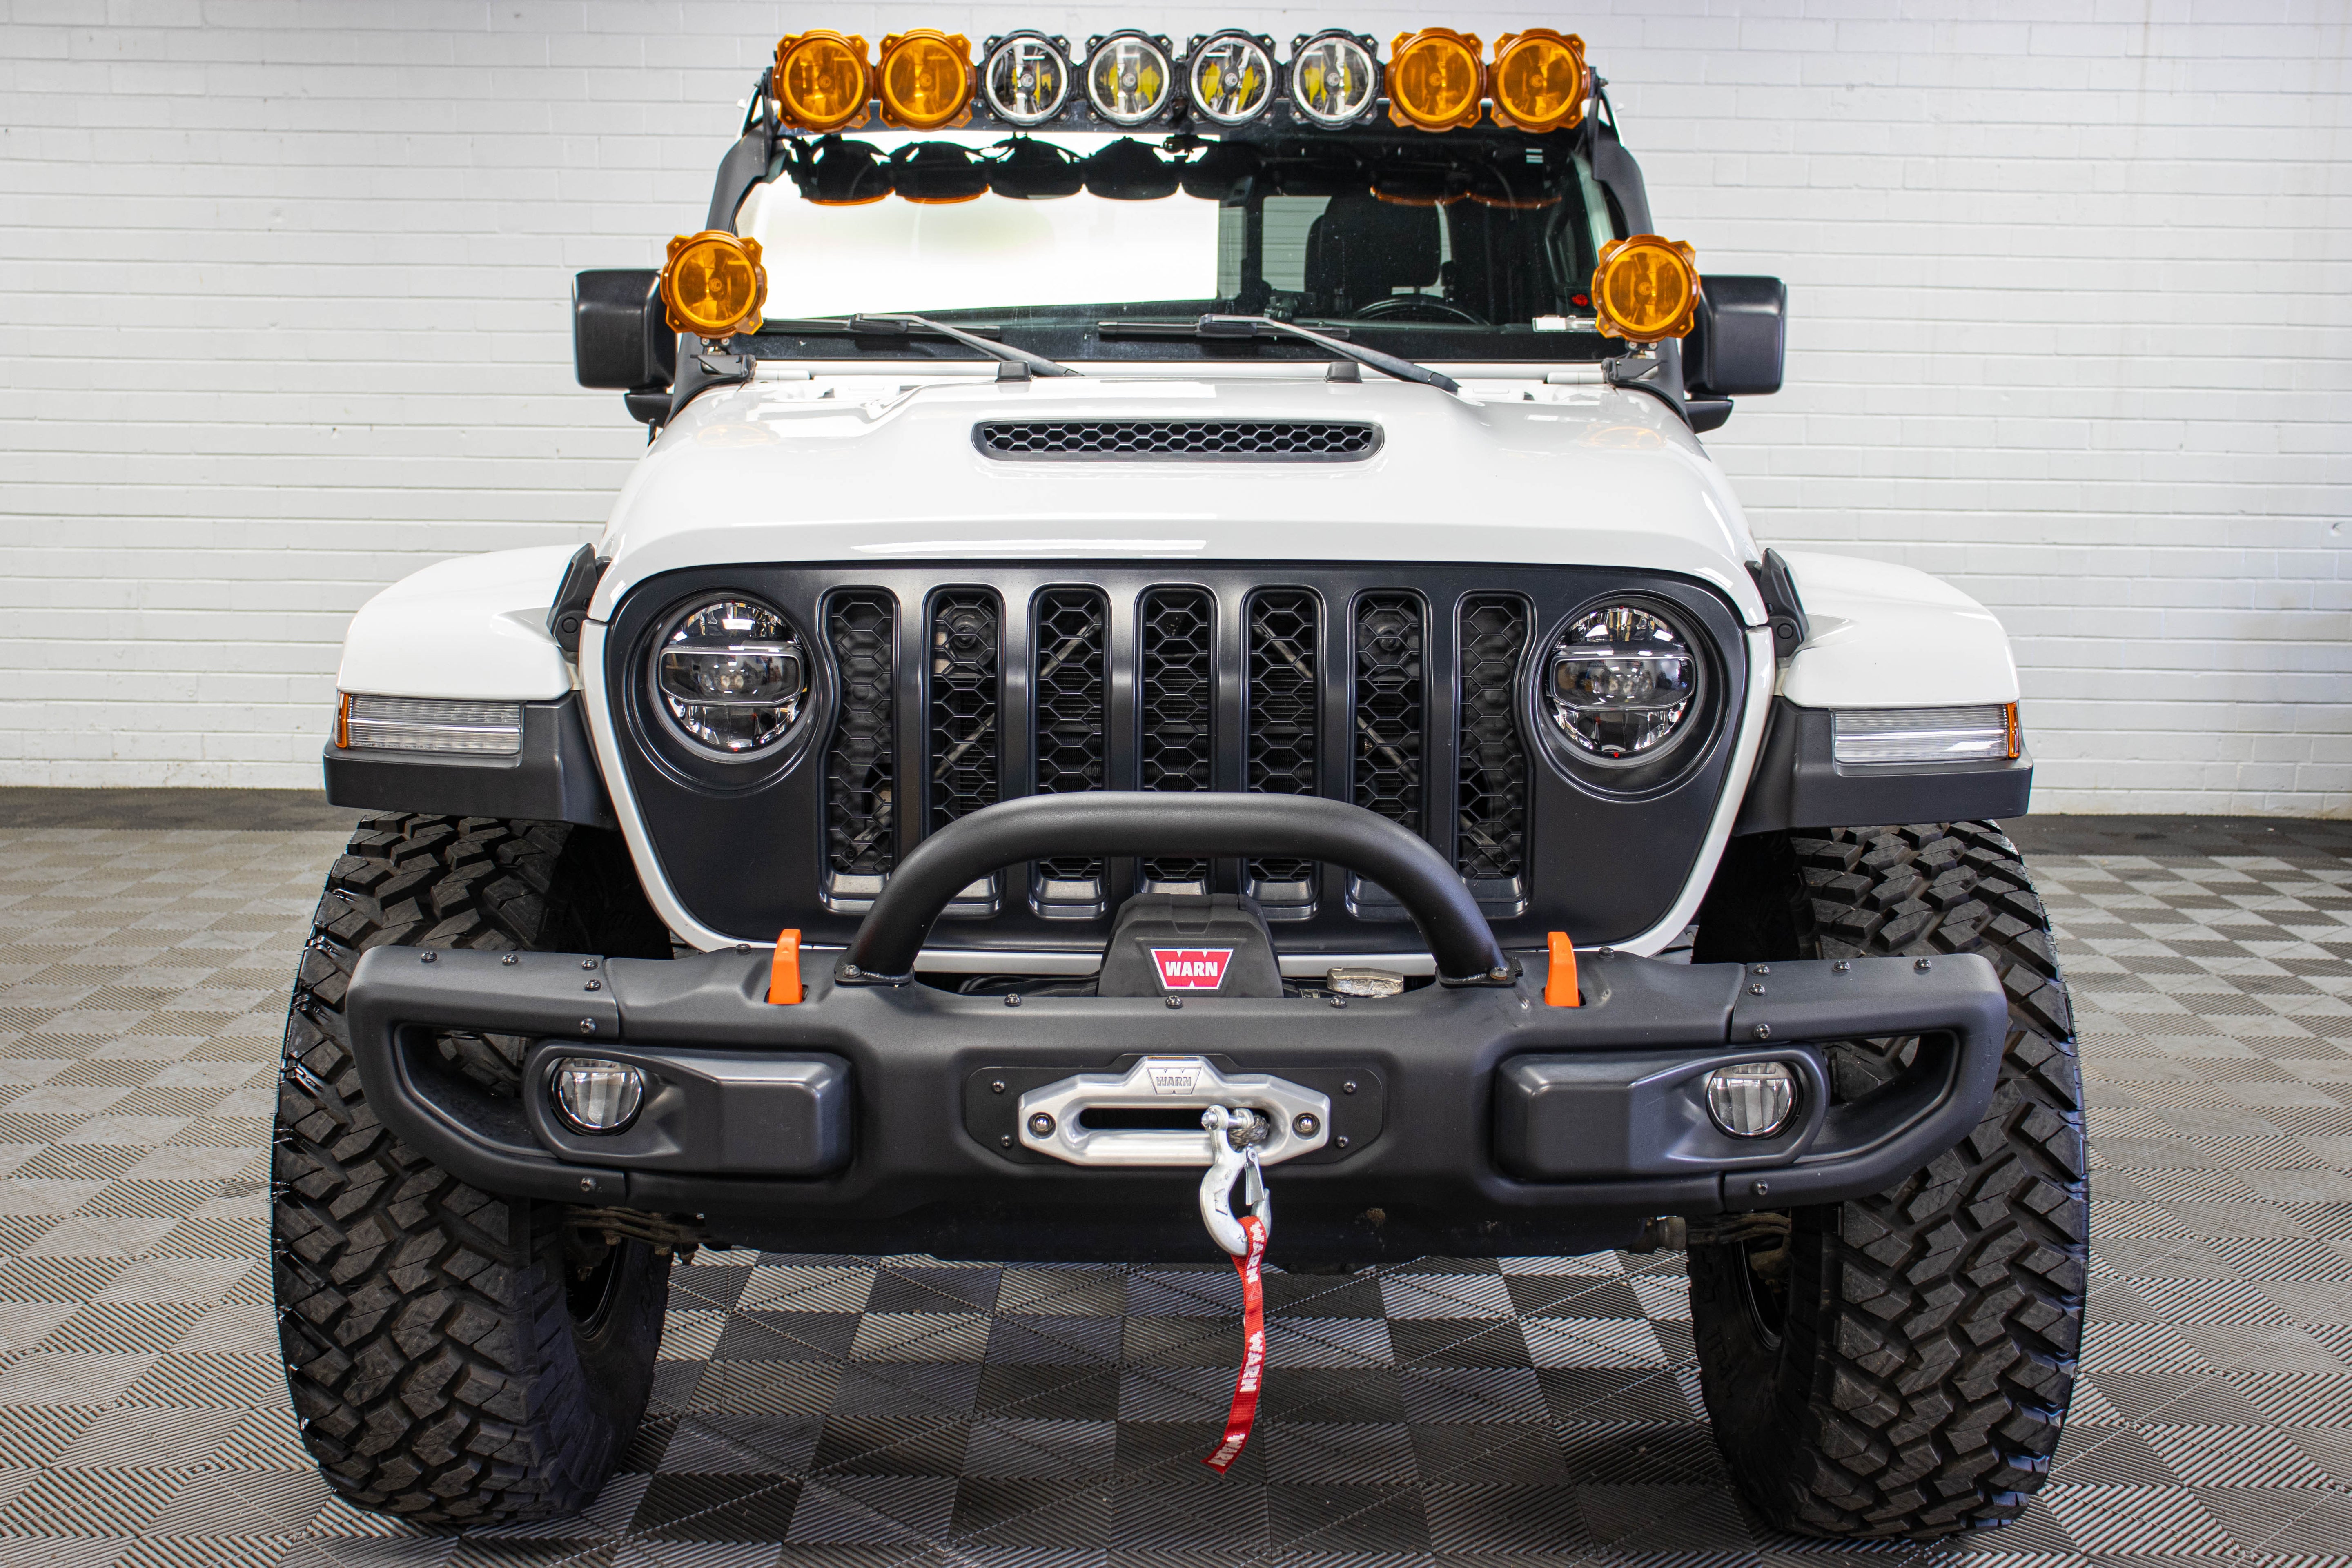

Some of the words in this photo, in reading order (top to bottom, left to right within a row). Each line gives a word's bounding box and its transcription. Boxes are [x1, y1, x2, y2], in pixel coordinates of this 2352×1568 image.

[1165, 961, 1218, 977] WARN
[1156, 1076, 1192, 1087] WARN
[1246, 1221, 1265, 1284] WARN
[1239, 1330, 1263, 1393] WARN
[1207, 1433, 1246, 1467] WARN
